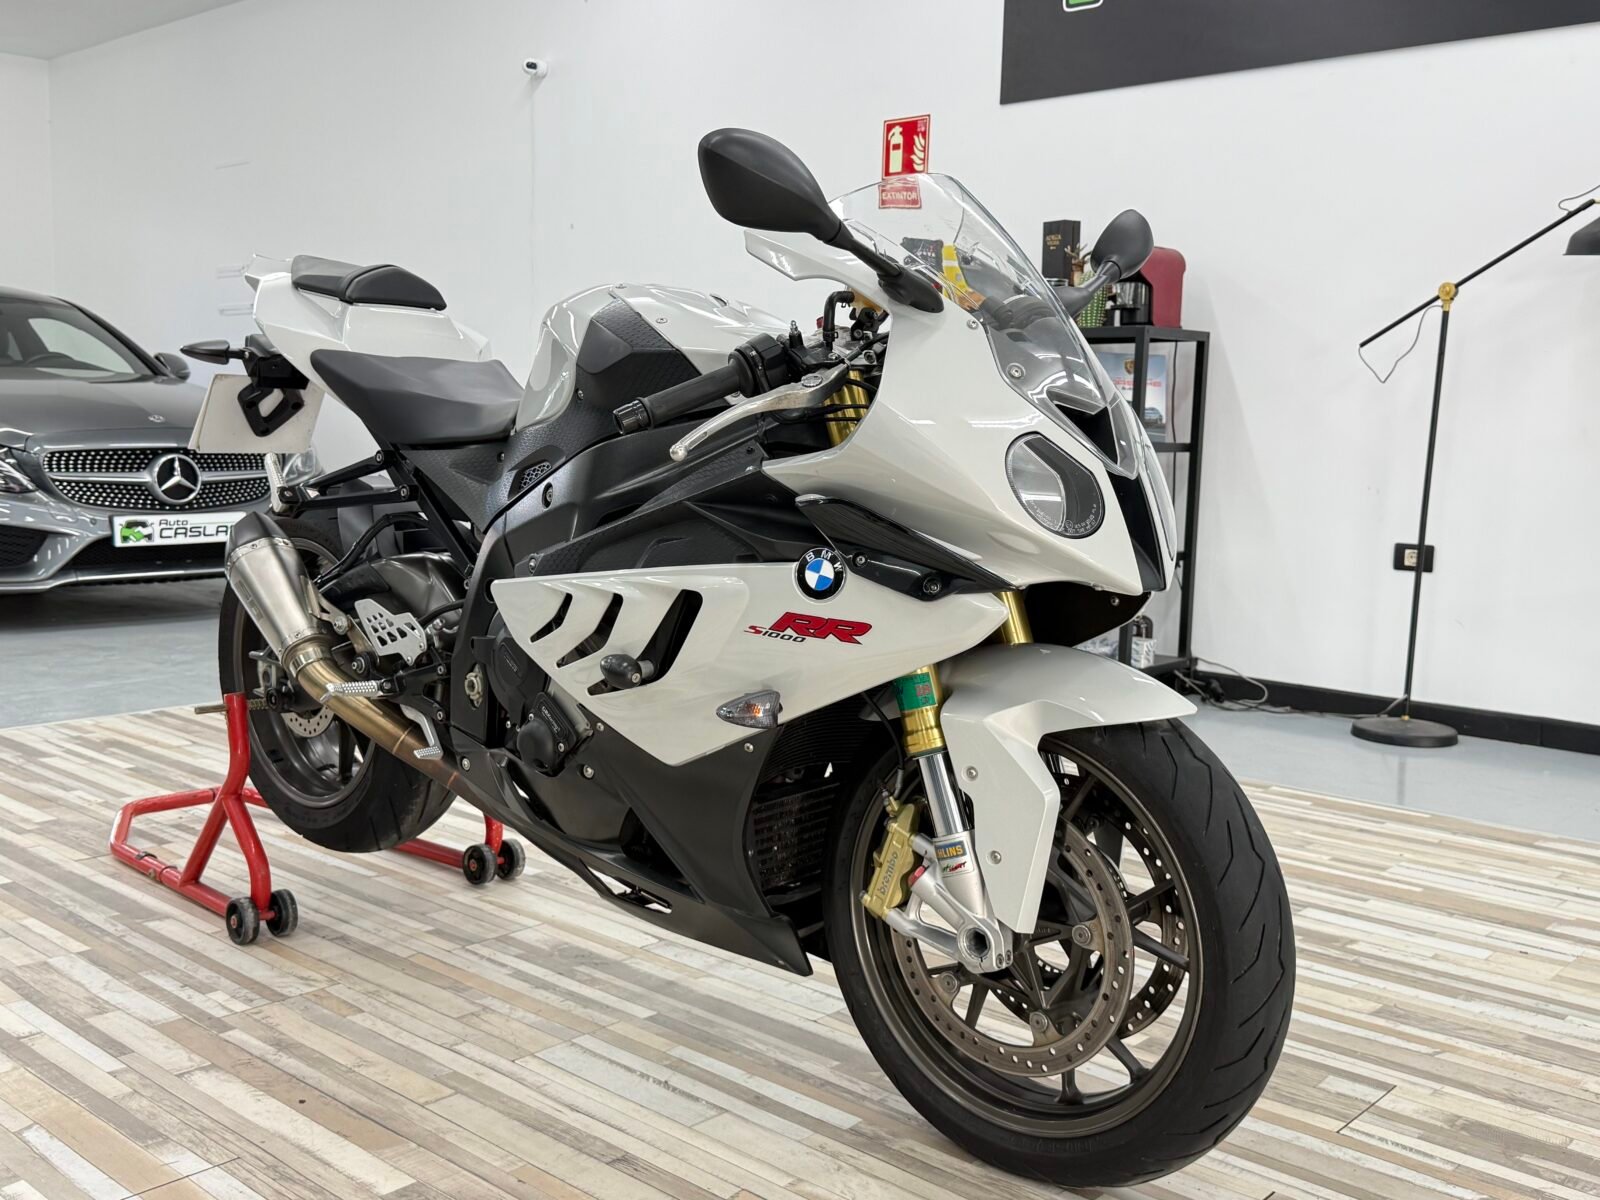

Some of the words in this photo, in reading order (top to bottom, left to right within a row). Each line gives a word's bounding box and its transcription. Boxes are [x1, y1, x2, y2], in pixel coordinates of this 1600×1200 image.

[882, 191, 918, 201] EXTINTOR
[160, 525, 234, 539] CASLA
[805, 549, 843, 572] BMW
[744, 625, 806, 643] S1000
[768, 611, 872, 645] RR
[877, 851, 899, 896] brembo
